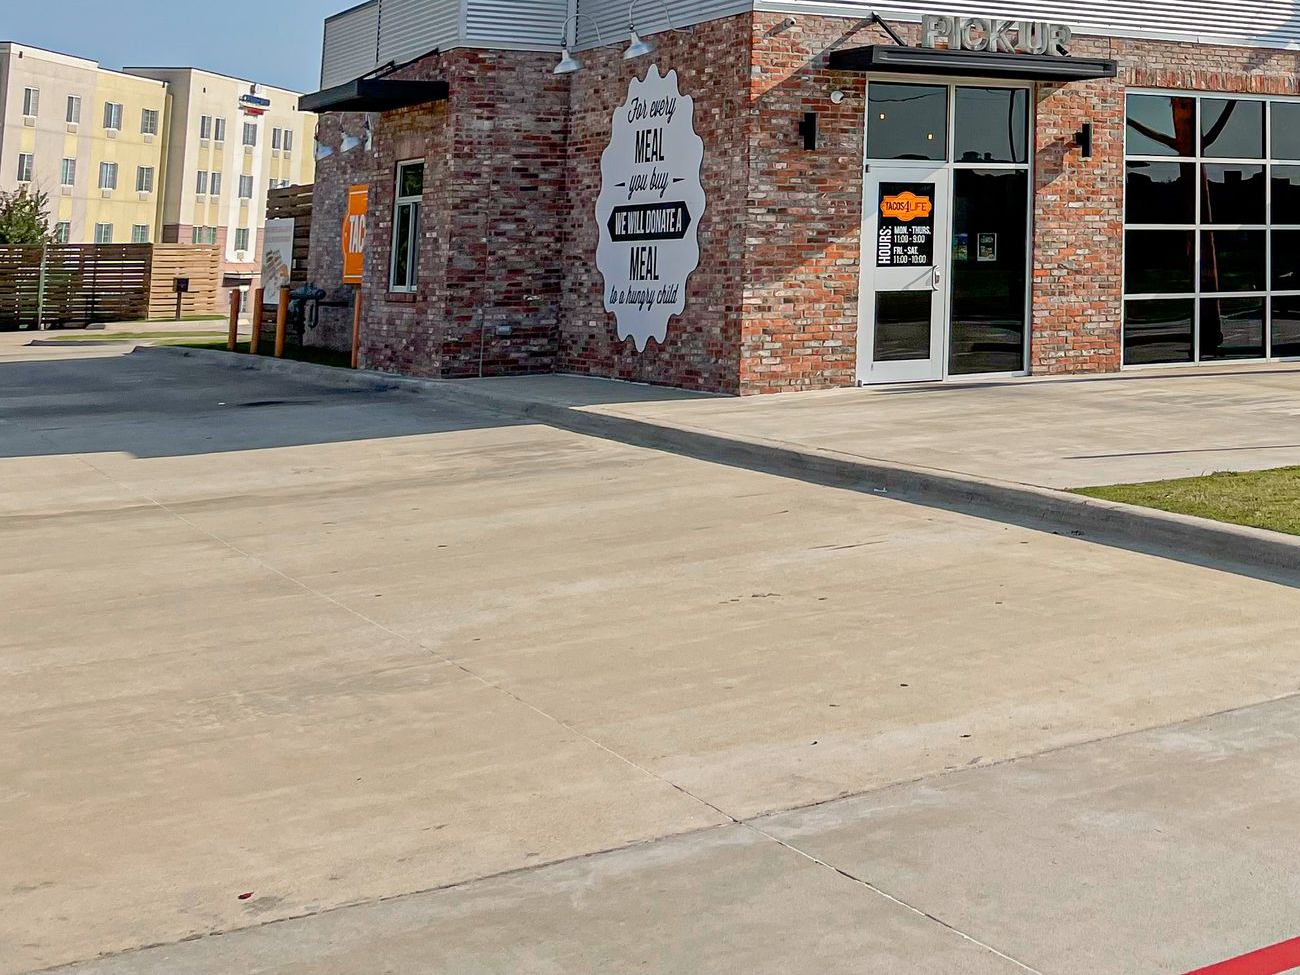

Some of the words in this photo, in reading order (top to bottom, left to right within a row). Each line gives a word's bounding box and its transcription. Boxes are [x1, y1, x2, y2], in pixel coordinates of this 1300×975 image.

[628, 97, 648, 123] For
[650, 95, 676, 124] every
[635, 128, 664, 163] MEAL
[628, 173, 648, 200] you
[650, 166, 669, 198] buy
[615, 212, 626, 235] WE
[628, 210, 644, 234] WILL
[646, 208, 675, 233] DONATE
[676, 207, 682, 232] A
[878, 226, 892, 264] HOURS:
[629, 246, 659, 280] MEAL
[610, 285, 618, 304] to
[619, 291, 625, 304] a
[626, 284, 656, 311] hungry
[657, 283, 679, 304] child
